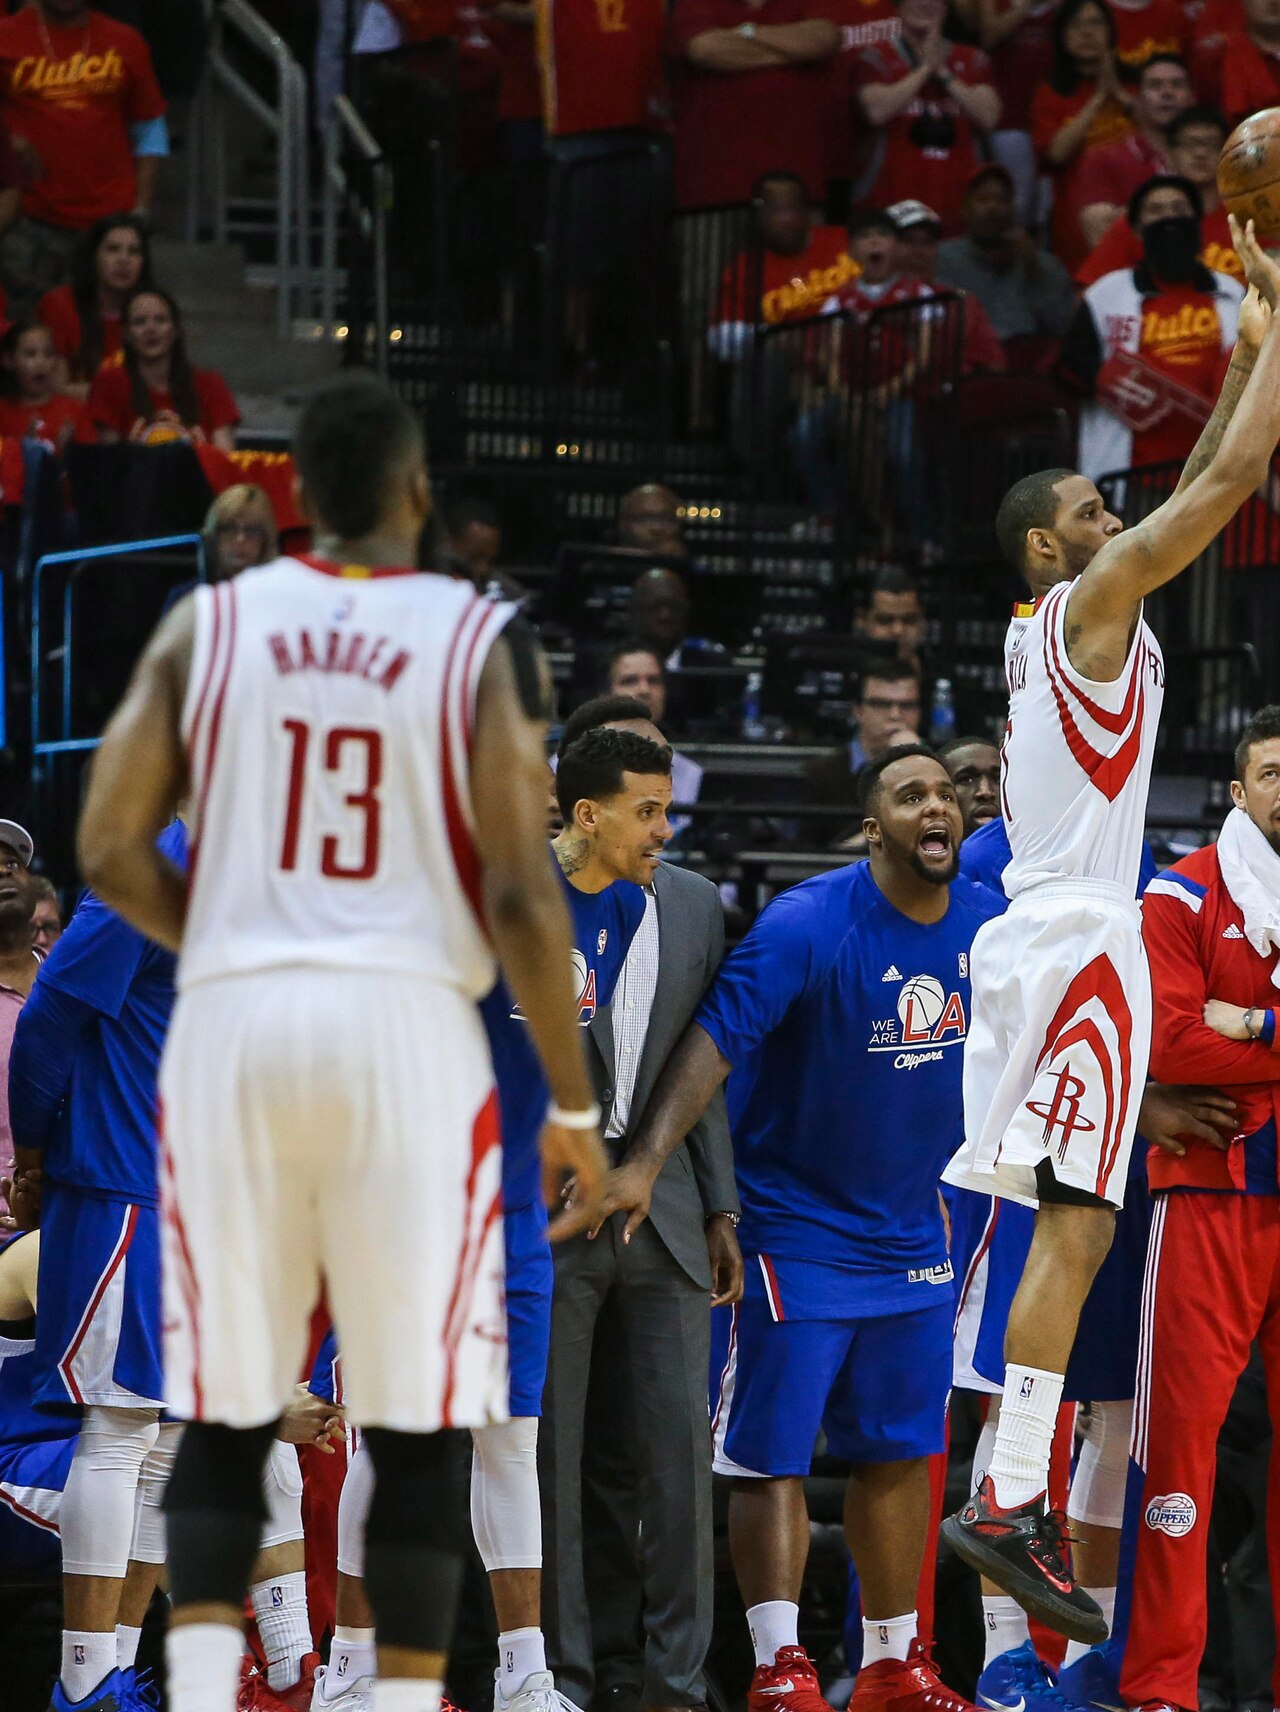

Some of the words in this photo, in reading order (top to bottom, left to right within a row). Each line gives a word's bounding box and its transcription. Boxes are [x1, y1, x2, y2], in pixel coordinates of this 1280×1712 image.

[267, 629, 413, 693] HARDEN
[278, 715, 385, 882] 13
[872, 1019, 896, 1034] WE
[902, 991, 967, 1044] LA
[869, 1034, 899, 1047] ARE
[893, 1049, 945, 1071] Clippers
[1146, 1507, 1192, 1528] CLIPPERS
